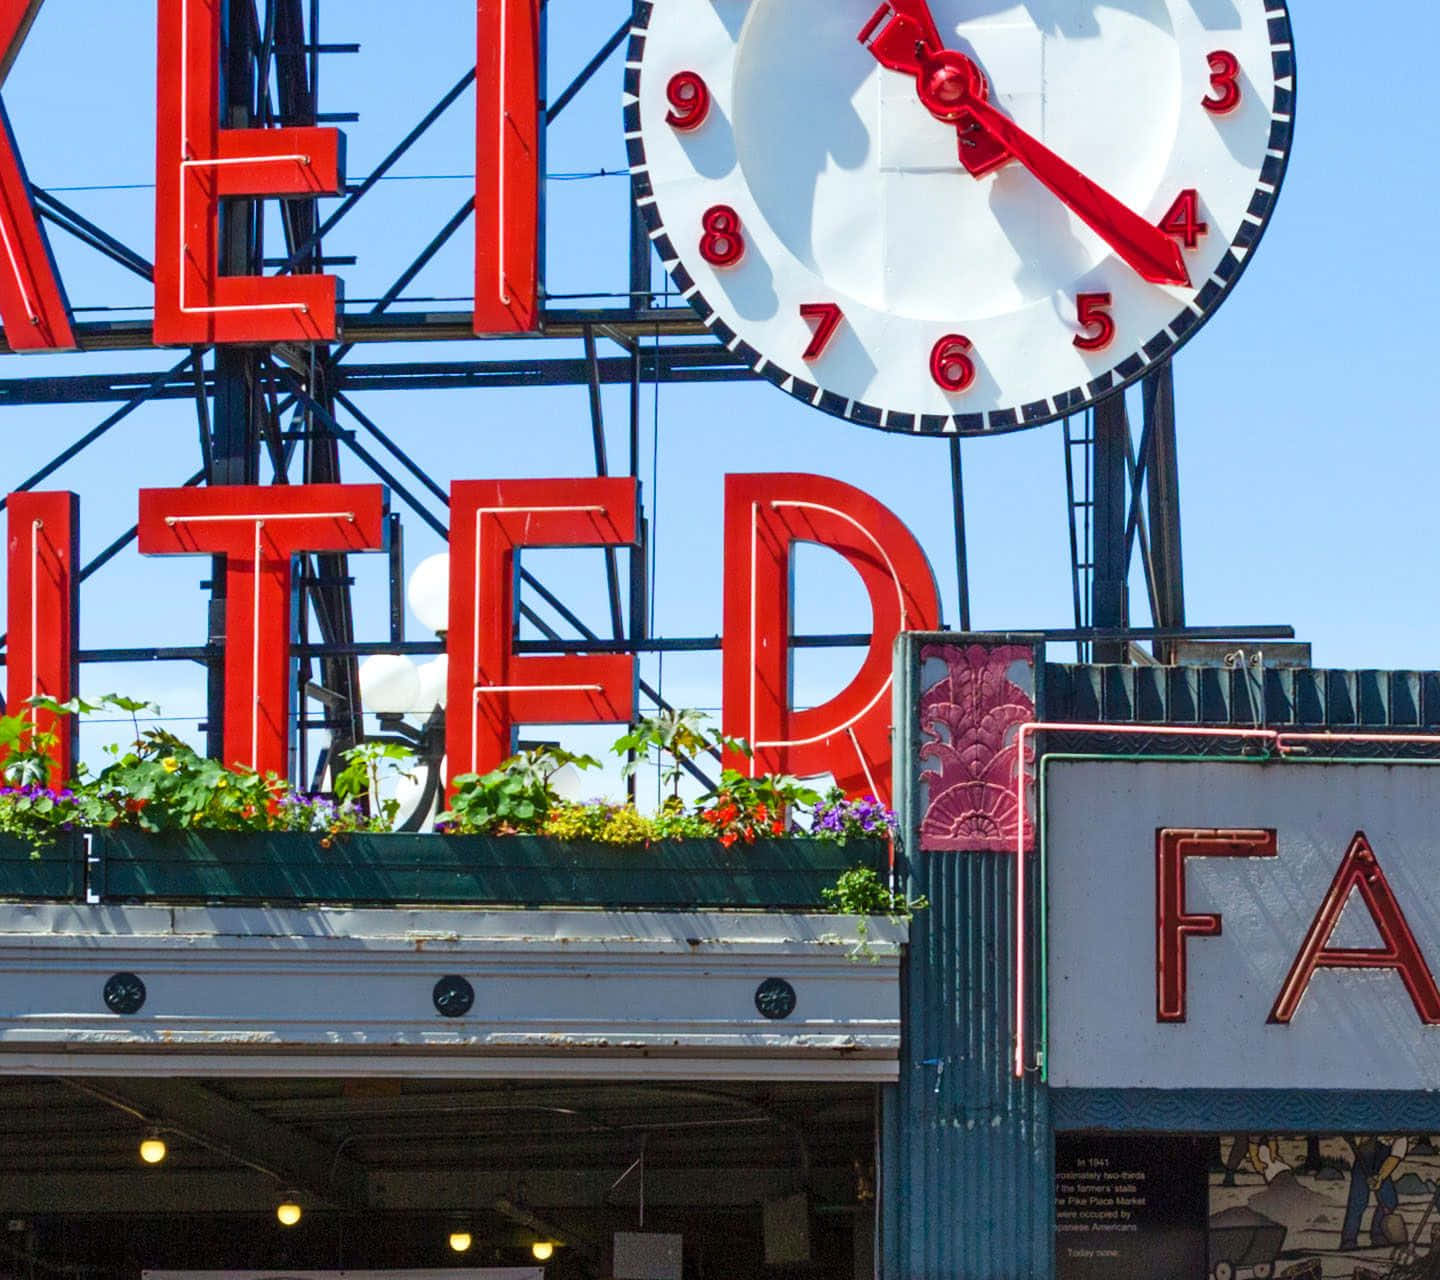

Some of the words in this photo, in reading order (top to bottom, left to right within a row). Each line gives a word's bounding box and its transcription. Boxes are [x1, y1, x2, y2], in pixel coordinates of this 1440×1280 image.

[664, 70, 711, 131] 9
[1200, 49, 1242, 115] 3
[698, 203, 746, 269] 8
[1158, 187, 1209, 251] 4
[798, 302, 845, 362] 7
[1071, 291, 1115, 353] 5
[928, 332, 976, 395] 6
